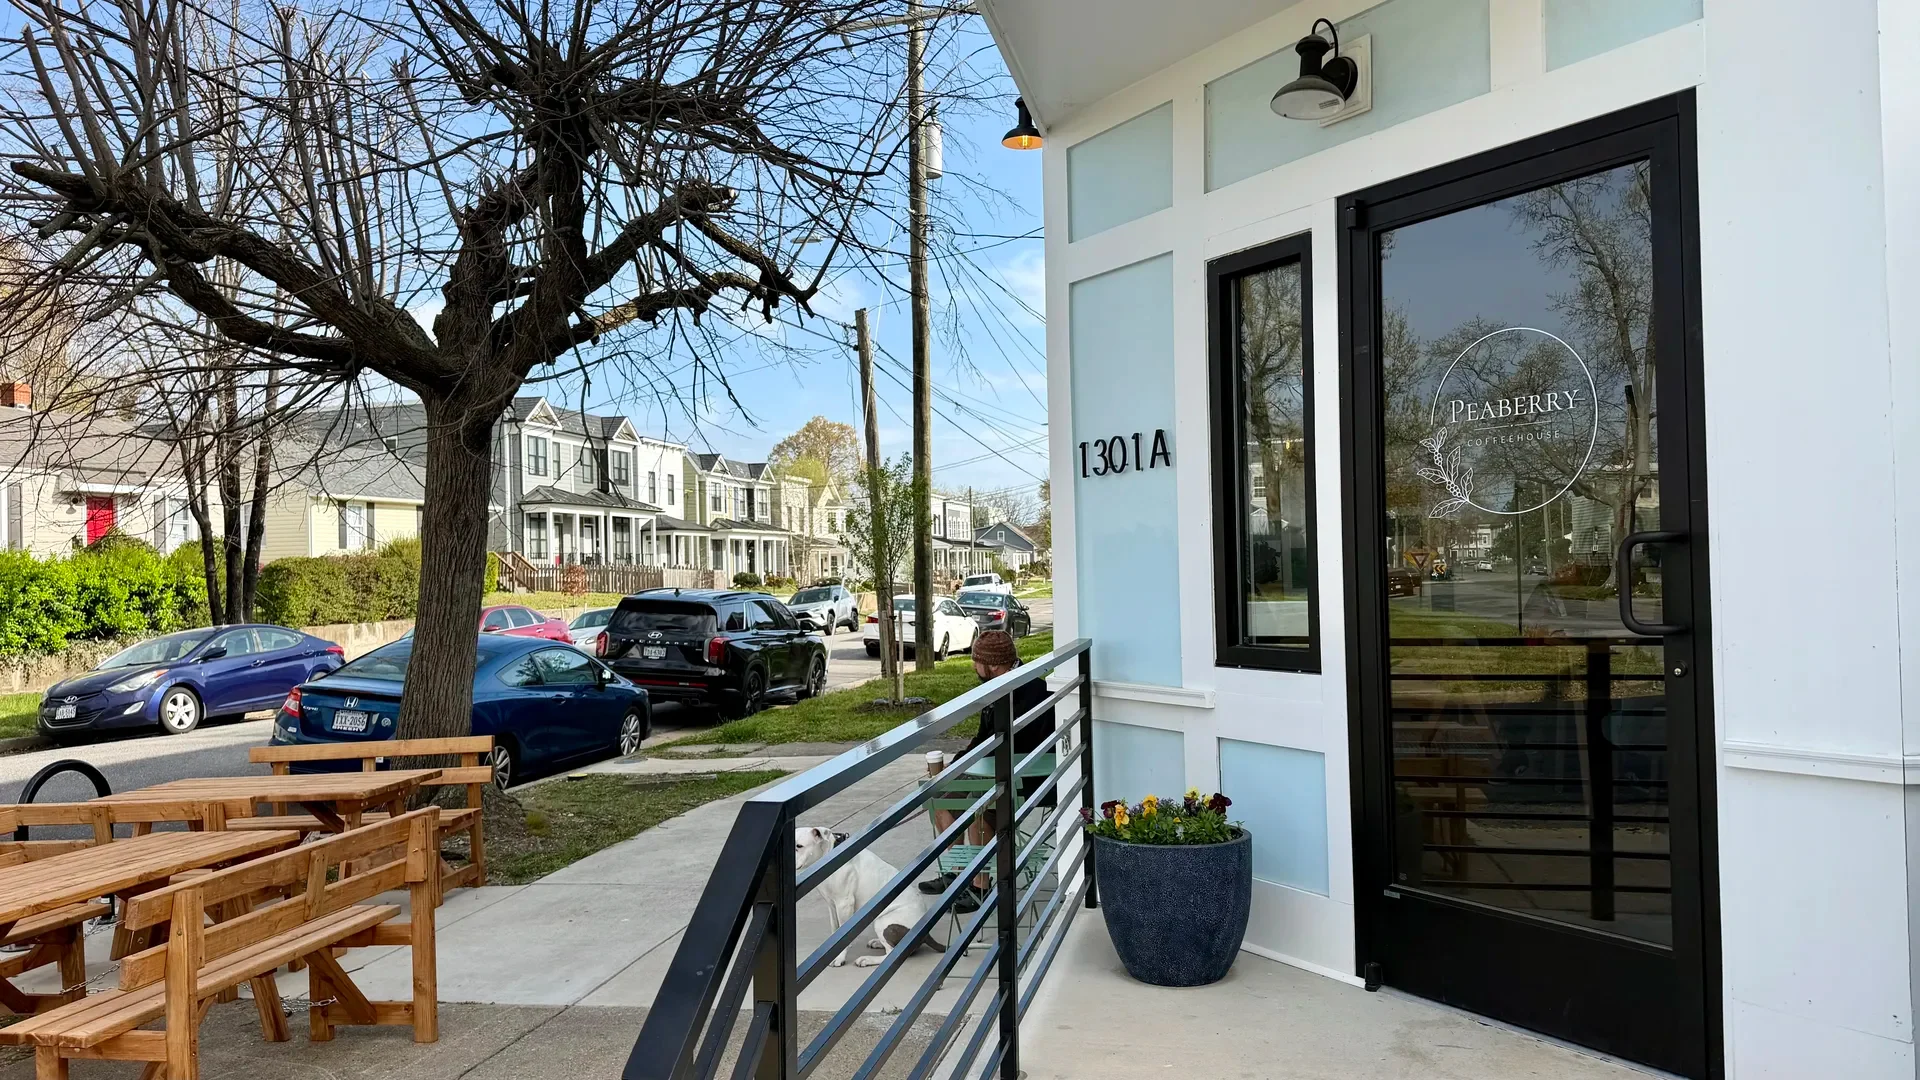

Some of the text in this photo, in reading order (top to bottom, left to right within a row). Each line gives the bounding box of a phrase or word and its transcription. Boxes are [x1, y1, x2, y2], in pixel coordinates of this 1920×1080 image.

[1450, 389, 1585, 423] PEABERRY
[1078, 429, 1170, 478] 1301A
[1467, 430, 1560, 447] COFFEEHOUSE
